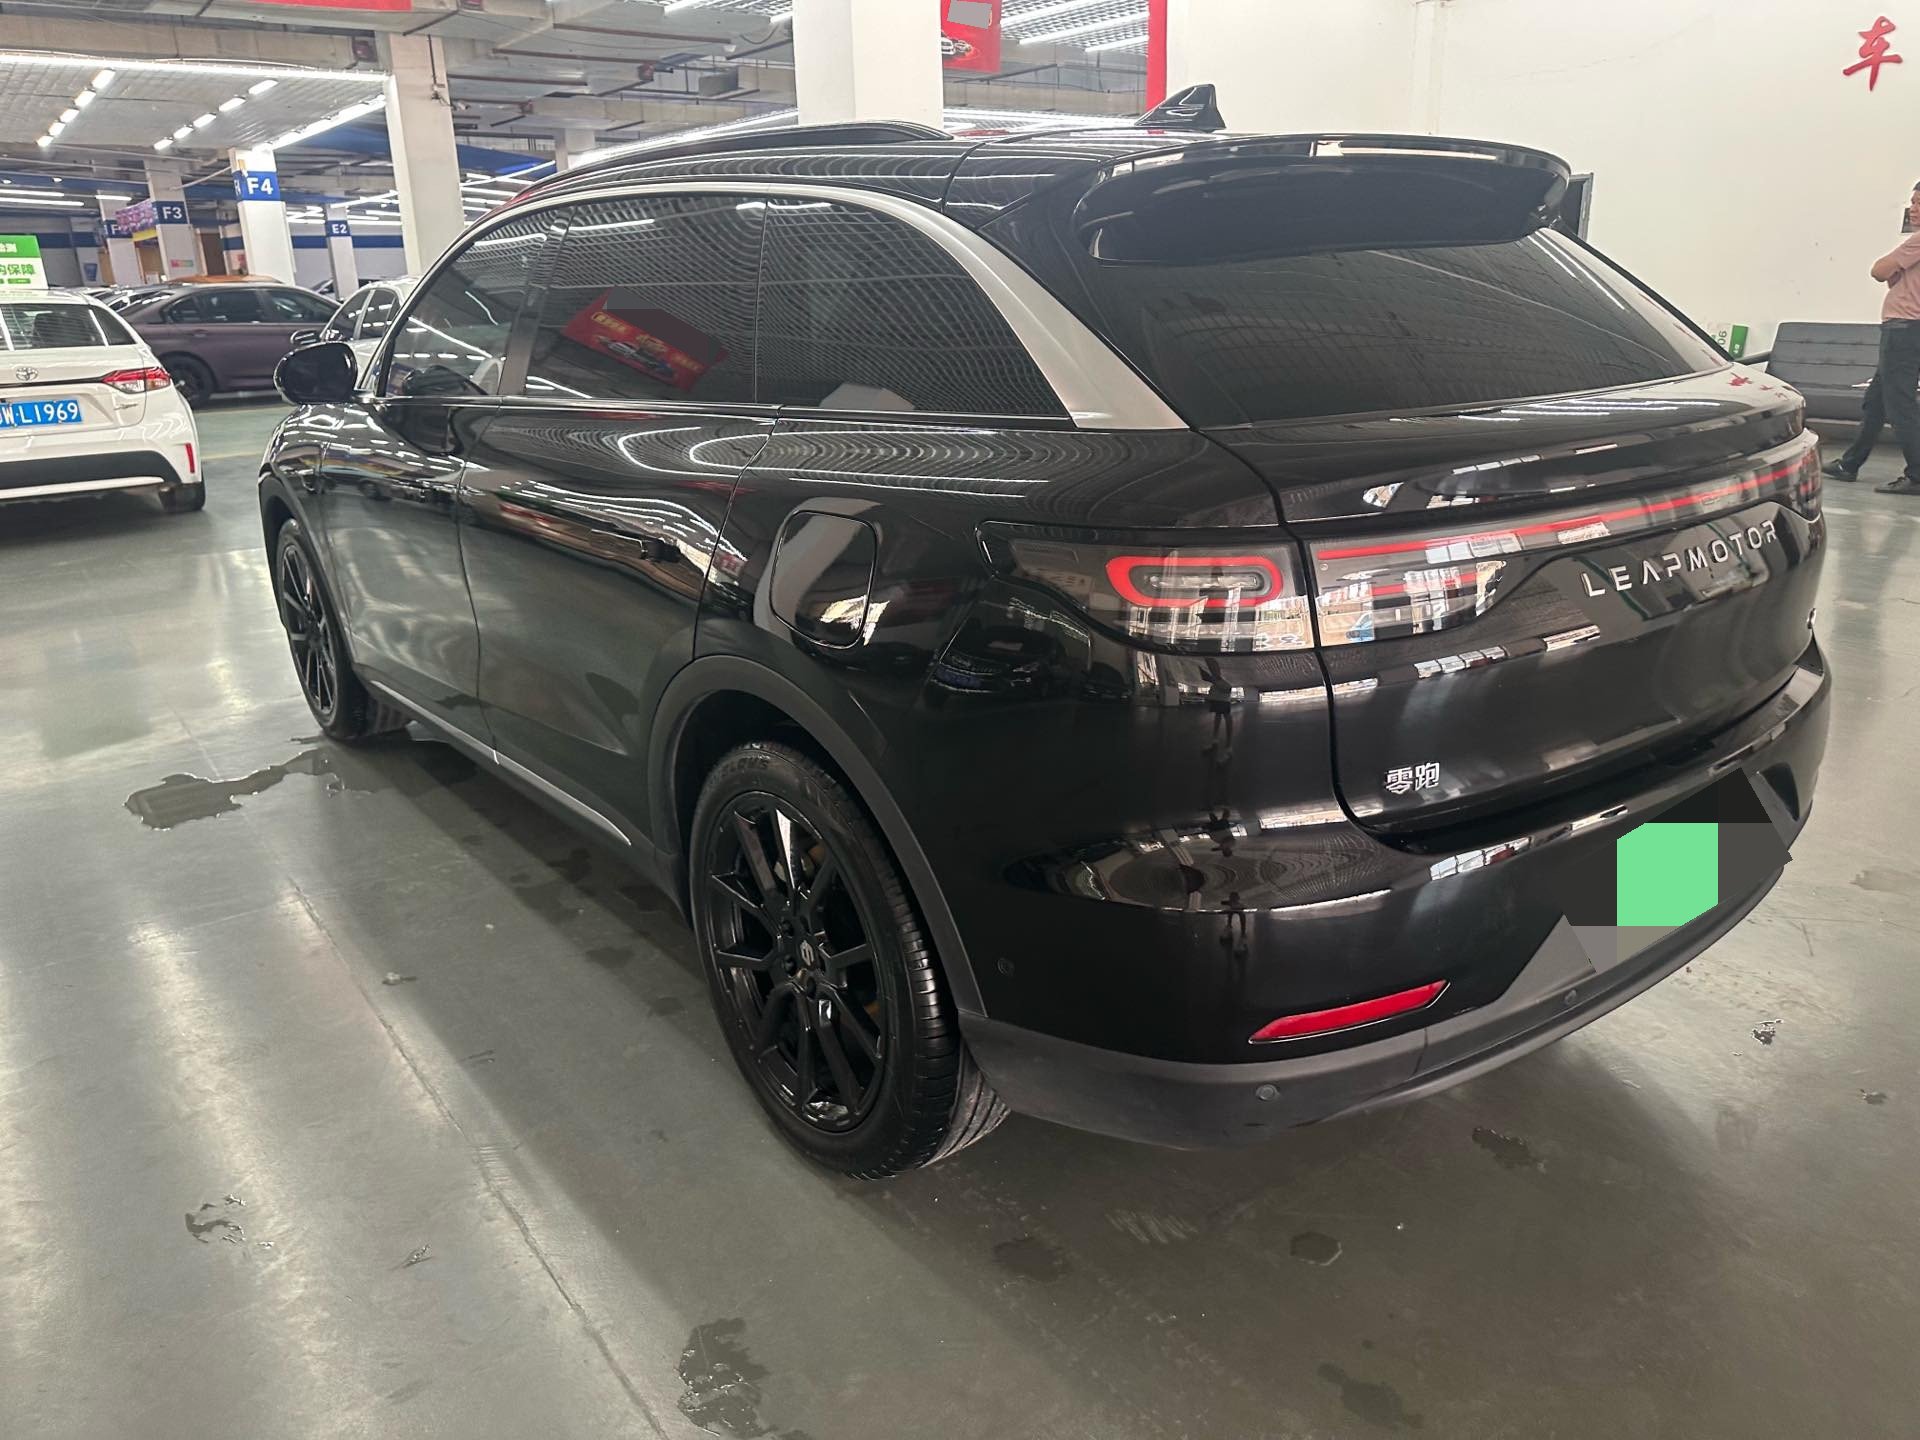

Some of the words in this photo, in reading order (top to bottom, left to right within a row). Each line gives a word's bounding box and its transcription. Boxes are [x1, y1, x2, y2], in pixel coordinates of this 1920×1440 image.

[1843, 16, 1903, 91] 车
[247, 177, 273, 195] F4
[162, 206, 182, 219] F3
[332, 224, 348, 234] E2
[1581, 519, 1777, 598] LEAPMOTOR
[1385, 762, 1440, 795] 零跑
